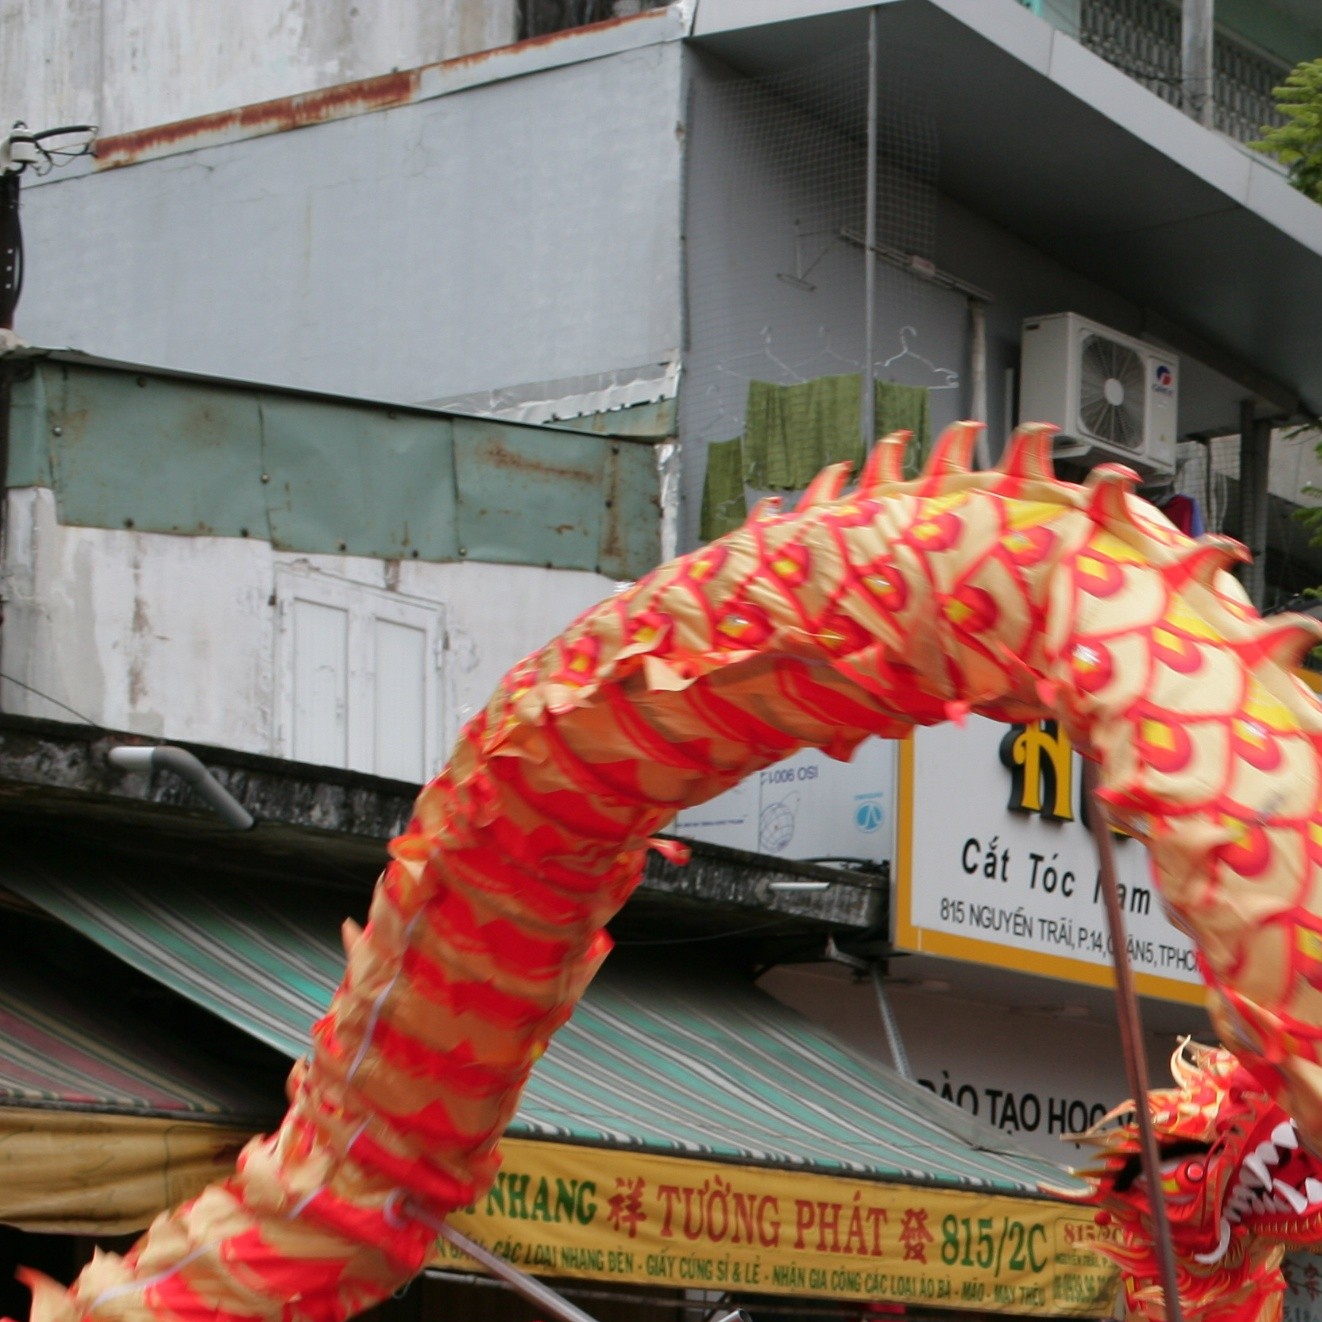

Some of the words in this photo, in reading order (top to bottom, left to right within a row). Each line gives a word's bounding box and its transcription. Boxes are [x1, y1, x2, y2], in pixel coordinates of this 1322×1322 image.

[962, 836, 1010, 883] Cắt
[1029, 853, 1075, 898] Tóc
[940, 898, 965, 924] 815
[1159, 944, 1198, 971] TPHC
[985, 1088, 1041, 1136] TẠO
[487, 1172, 597, 1226] NHANG
[607, 1176, 648, 1239] 祥
[657, 1174, 782, 1248] TƯỜNG
[794, 1190, 888, 1257] PHÁT
[940, 1214, 1048, 1278] 815/2C
[731, 1266, 741, 1284] &
